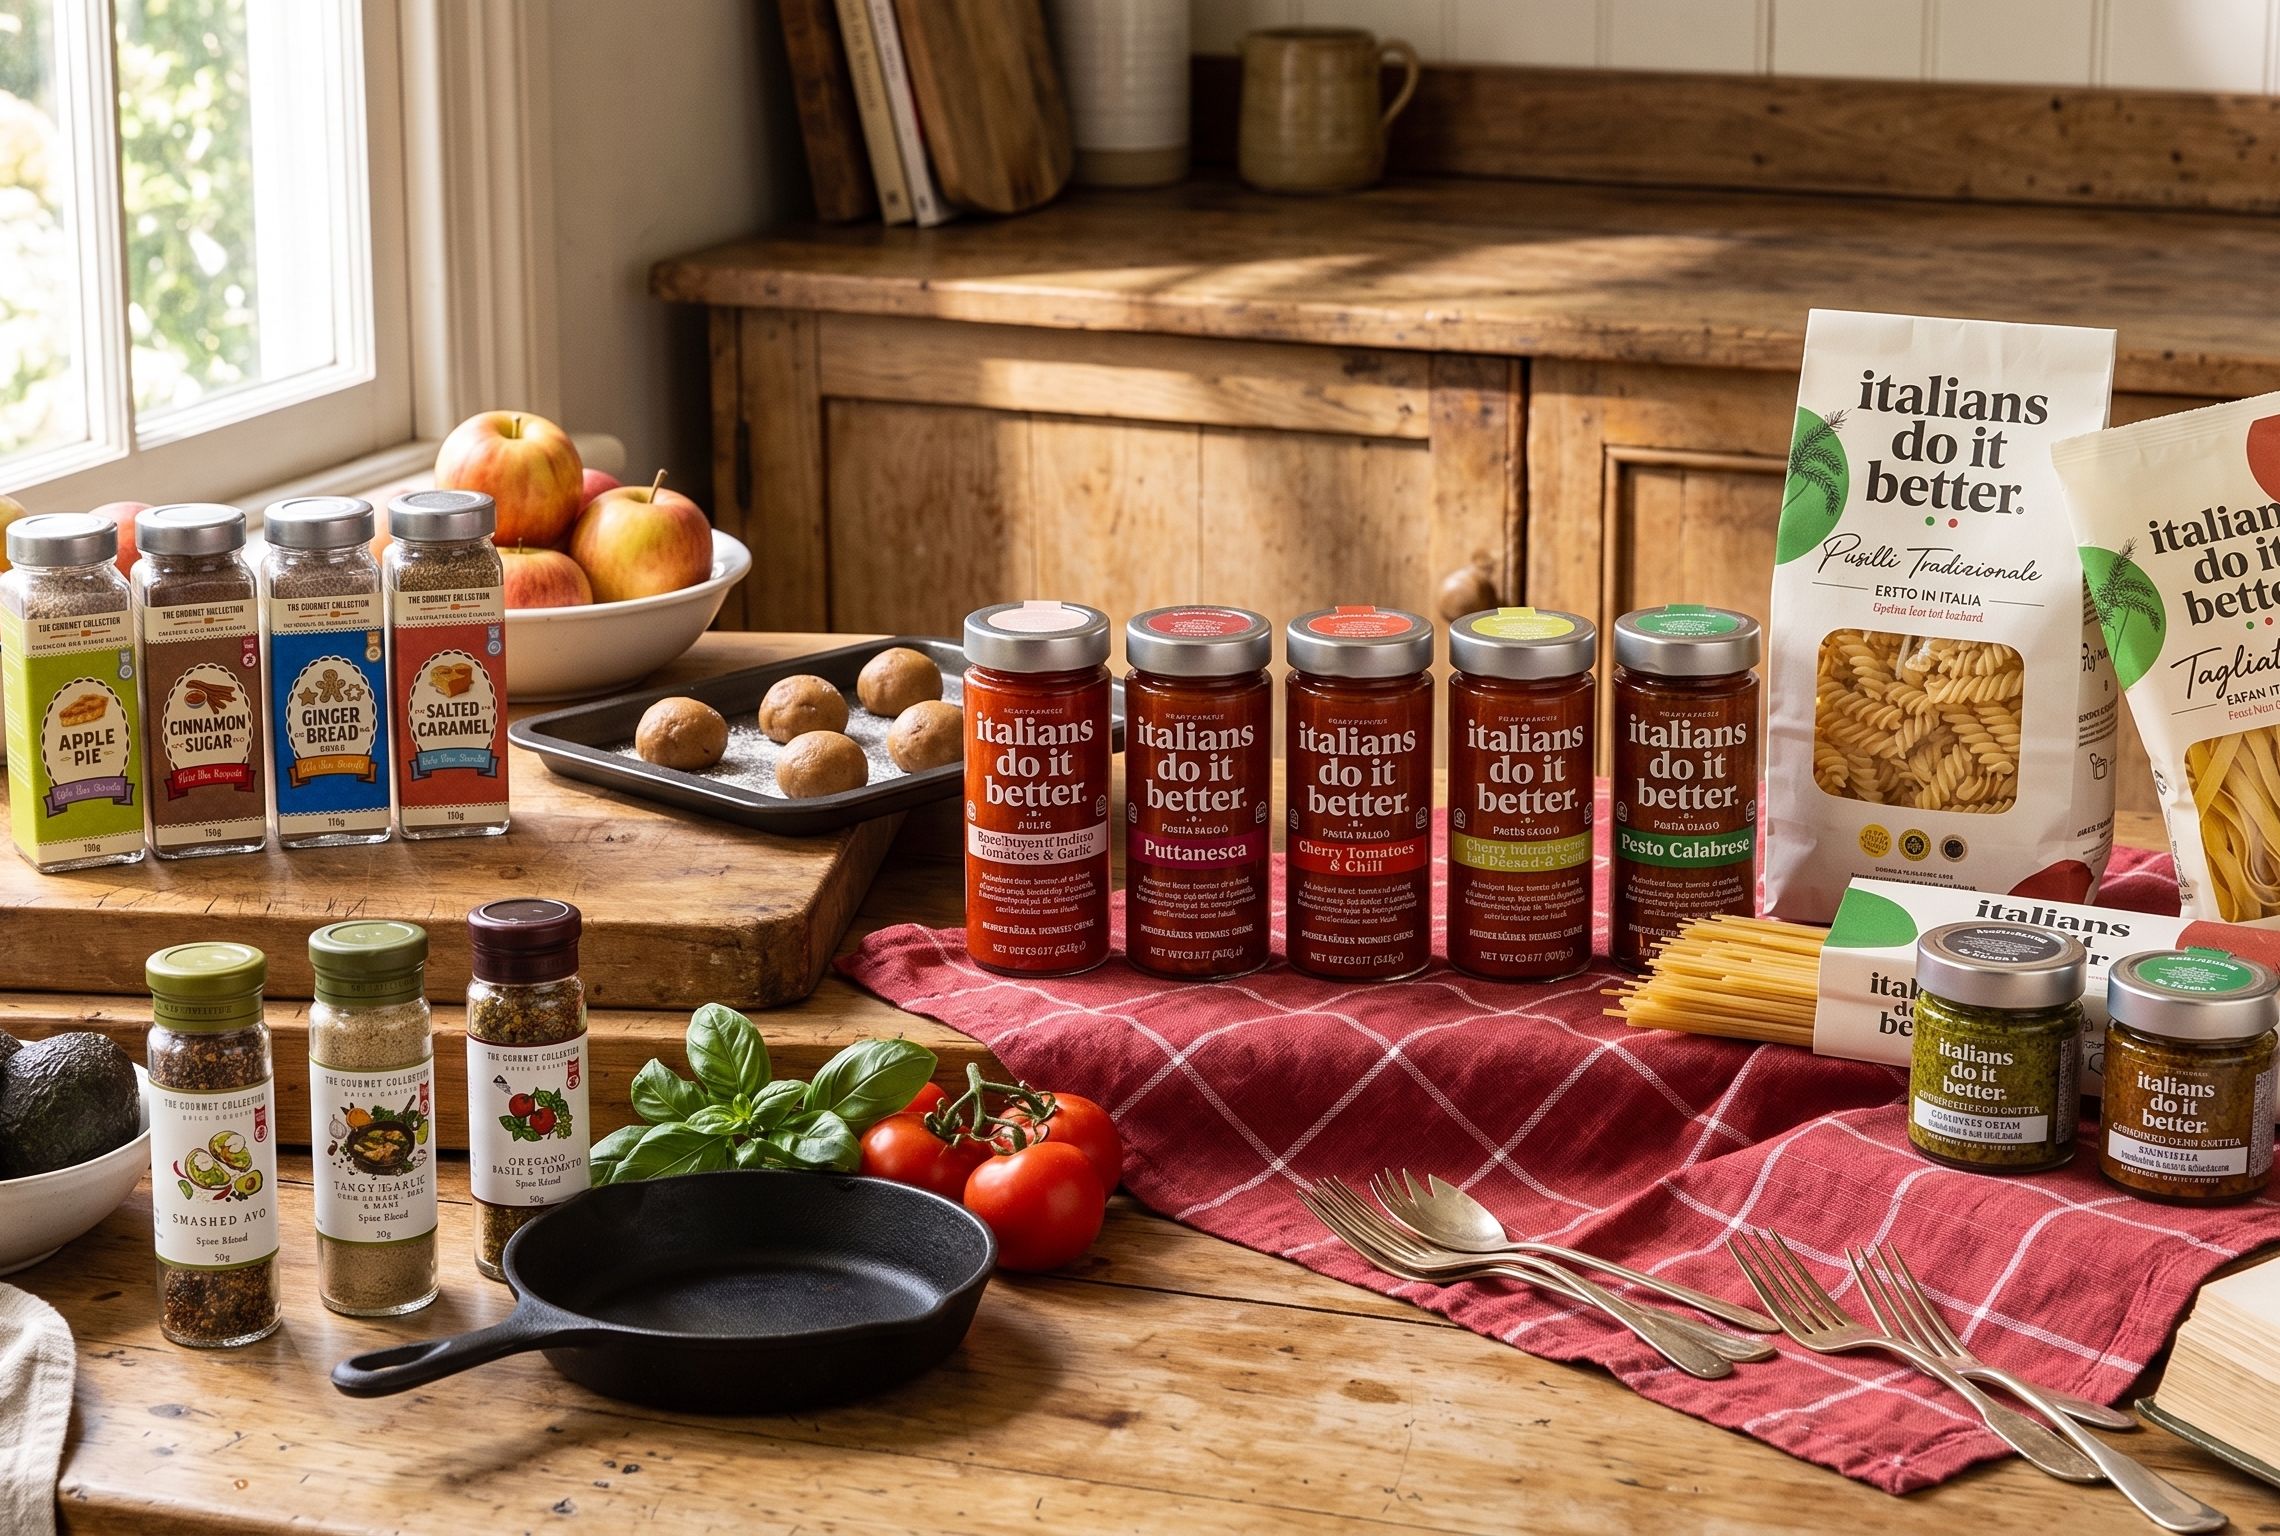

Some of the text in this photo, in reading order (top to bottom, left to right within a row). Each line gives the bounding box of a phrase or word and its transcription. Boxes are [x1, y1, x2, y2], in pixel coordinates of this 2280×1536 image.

[1857, 369, 2049, 425] italians
[1891, 420, 2008, 469] do it
[1906, 547, 2043, 581] Tradizionale
[2194, 536, 2280, 584] do it
[1921, 589, 1936, 602] IN
[1940, 591, 1981, 606] ITALIA
[302, 706, 361, 727] GINGER
[426, 701, 480, 719] SALTED
[170, 714, 246, 736] CINNAMON
[306, 725, 359, 744] BREAD
[418, 719, 490, 737] CARAMEL
[976, 711, 1094, 746] italians
[1137, 715, 1254, 751] italians
[1467, 718, 1584, 753] italians
[1629, 713, 1747, 749] italians
[59, 728, 115, 751] APPLE
[185, 734, 232, 752] SUGAR
[1299, 721, 1416, 756] italians
[74, 748, 101, 766] PIE
[996, 748, 1074, 778] do it
[1157, 753, 1234, 782] do it
[1489, 754, 1567, 784] do it
[1650, 751, 1727, 780] do it
[1318, 757, 1396, 787] do it
[985, 775, 1087, 807] better.
[1145, 779, 1247, 812] better.
[1477, 783, 1579, 815] better.
[1637, 778, 1739, 810] better.
[980, 843, 1091, 861] Tomatoes & Garlic
[1144, 838, 1247, 861] Puttanesca
[1299, 840, 1414, 859] Cherry Tomatoes
[1466, 838, 1507, 858] Cherry
[1622, 833, 1750, 859] Pesto Calabrese
[1330, 859, 1340, 871] &
[1975, 899, 2131, 938] italians
[1939, 1037, 2014, 1066] italians
[1950, 1061, 1997, 1083] do it
[2136, 1070, 2215, 1098] italians
[2150, 1094, 2198, 1116] do it
[492, 1165, 523, 1176] BASIL
[508, 1153, 565, 1166] OREGANO
[333, 1180, 375, 1193] TANGY
[529, 1195, 544, 1204] 50g
[172, 1208, 267, 1227] SMASHED AVO
[214, 1253, 231, 1263] 50g
